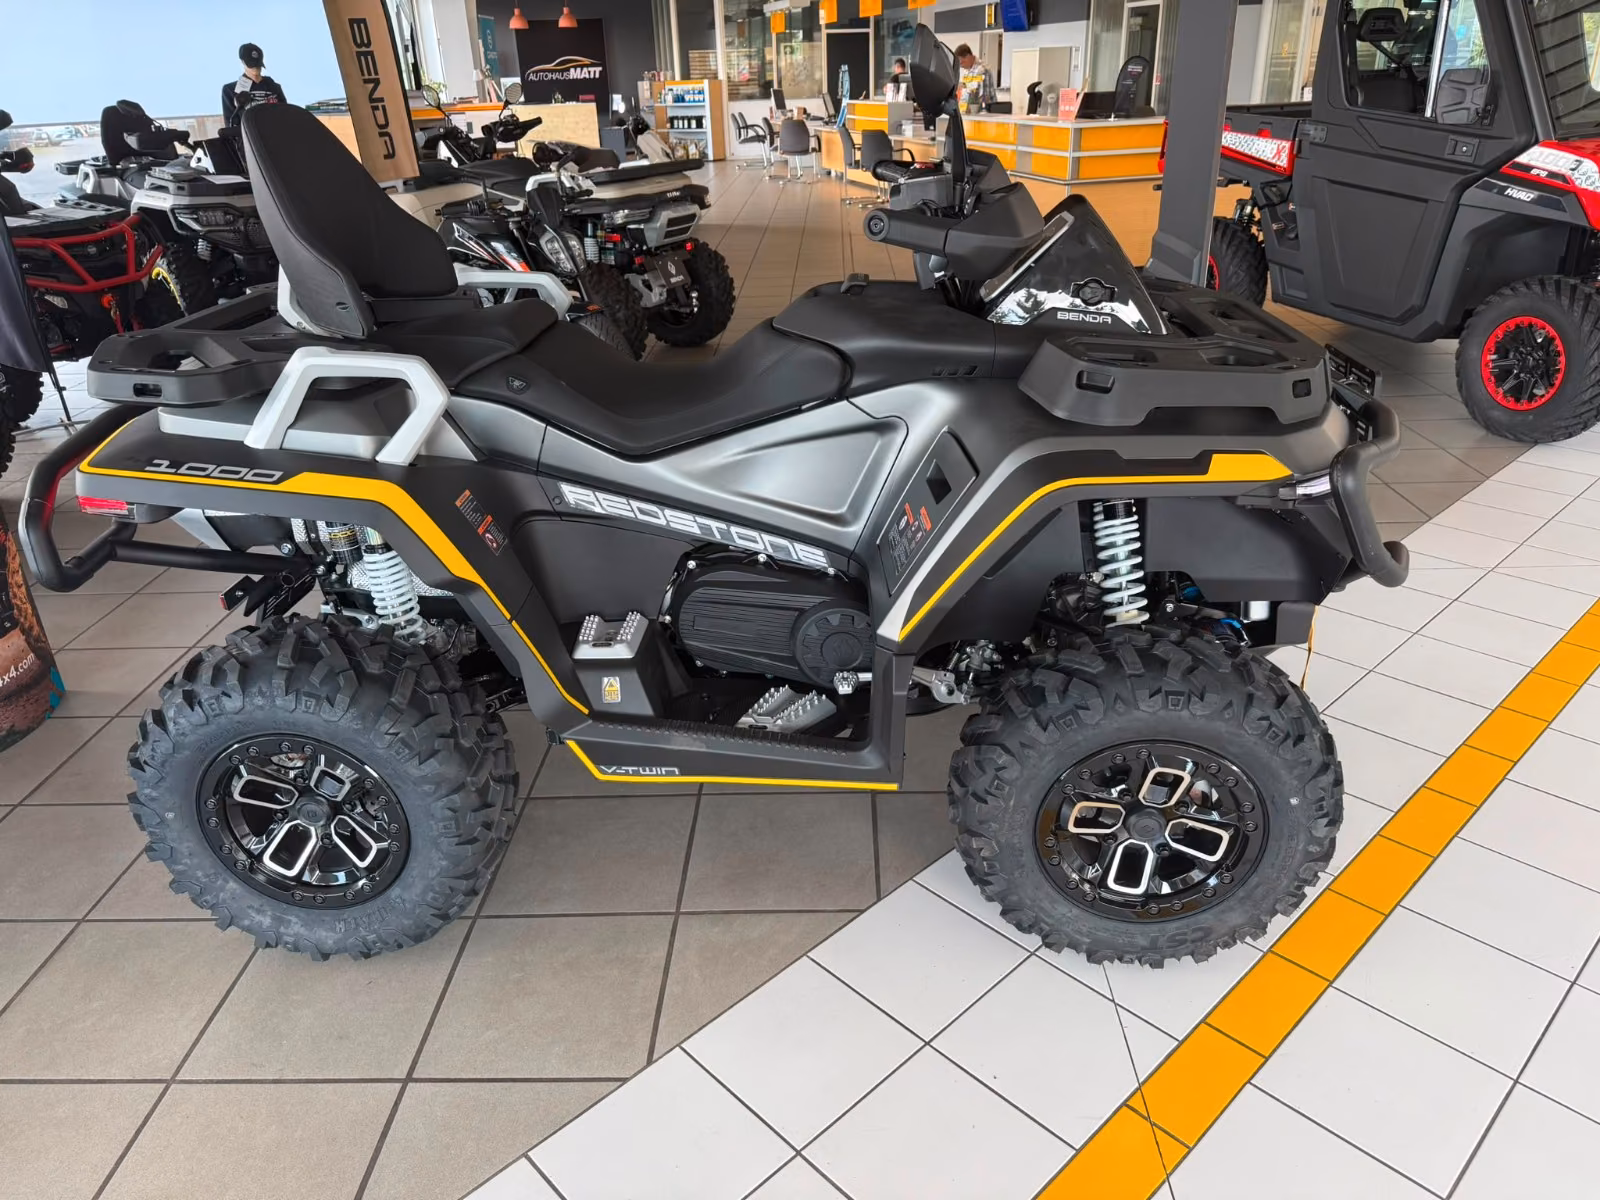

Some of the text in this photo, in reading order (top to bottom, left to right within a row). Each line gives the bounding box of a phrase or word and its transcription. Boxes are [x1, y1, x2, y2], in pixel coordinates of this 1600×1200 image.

[348, 18, 396, 160] BENDA
[1057, 311, 1112, 324] BENDA
[144, 459, 284, 483] 1000
[559, 481, 829, 568] REDSTONE
[599, 765, 680, 775] V-TWIN
